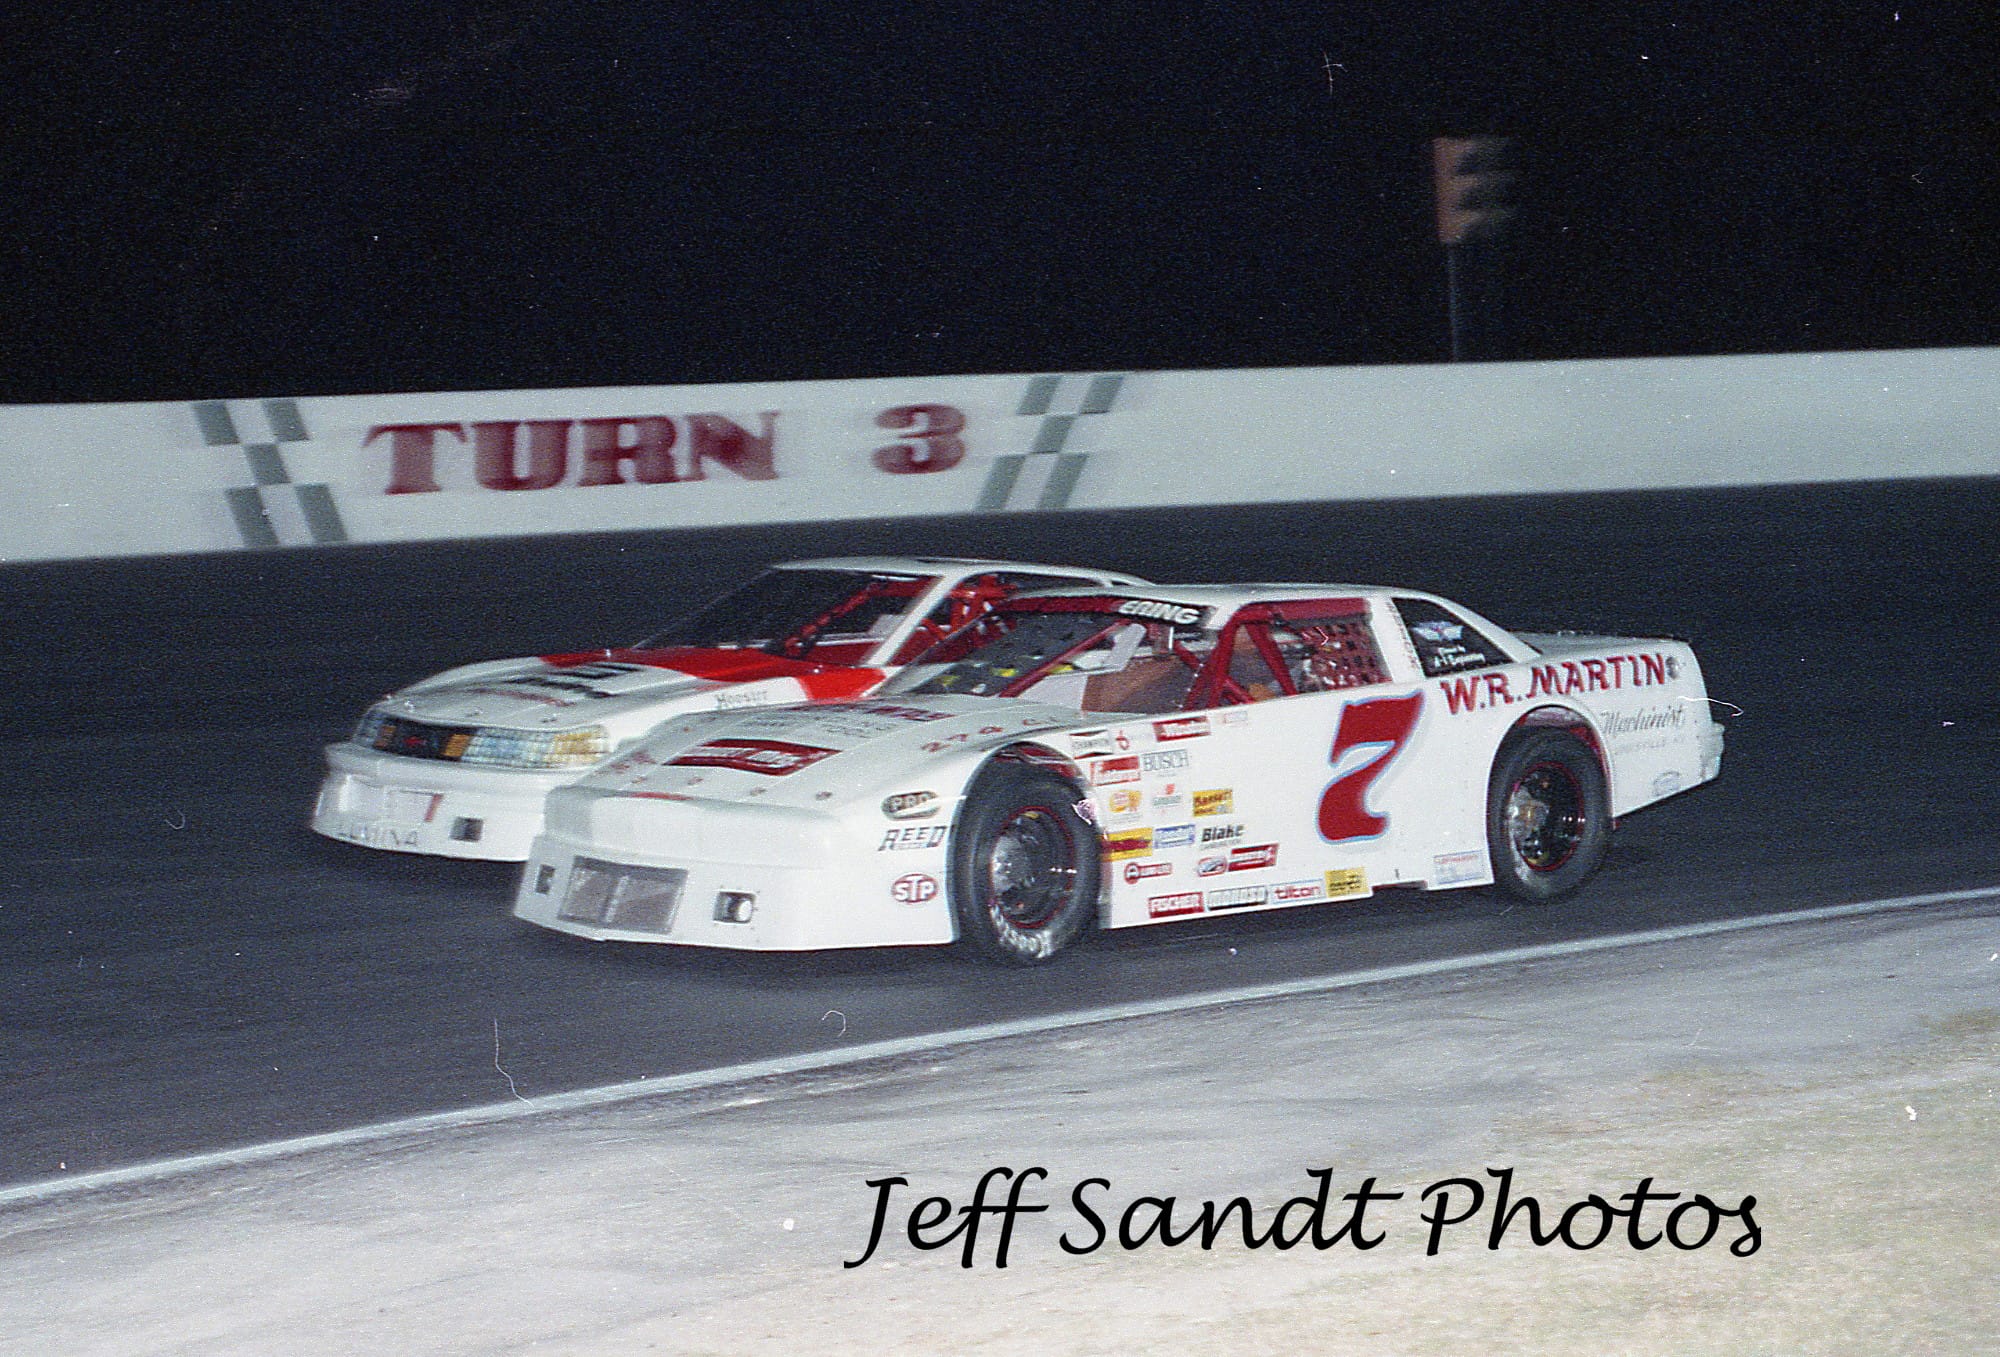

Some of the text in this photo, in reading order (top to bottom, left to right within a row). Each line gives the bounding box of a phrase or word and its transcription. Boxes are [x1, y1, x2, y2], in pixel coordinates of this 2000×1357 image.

[361, 402, 968, 496] TURN 3
[1525, 652, 1666, 699] MARTIN
[1316, 689, 1426, 844] 7
[878, 825, 948, 852] REED
[1201, 823, 1246, 843] Blake
[893, 873, 937, 902] STP
